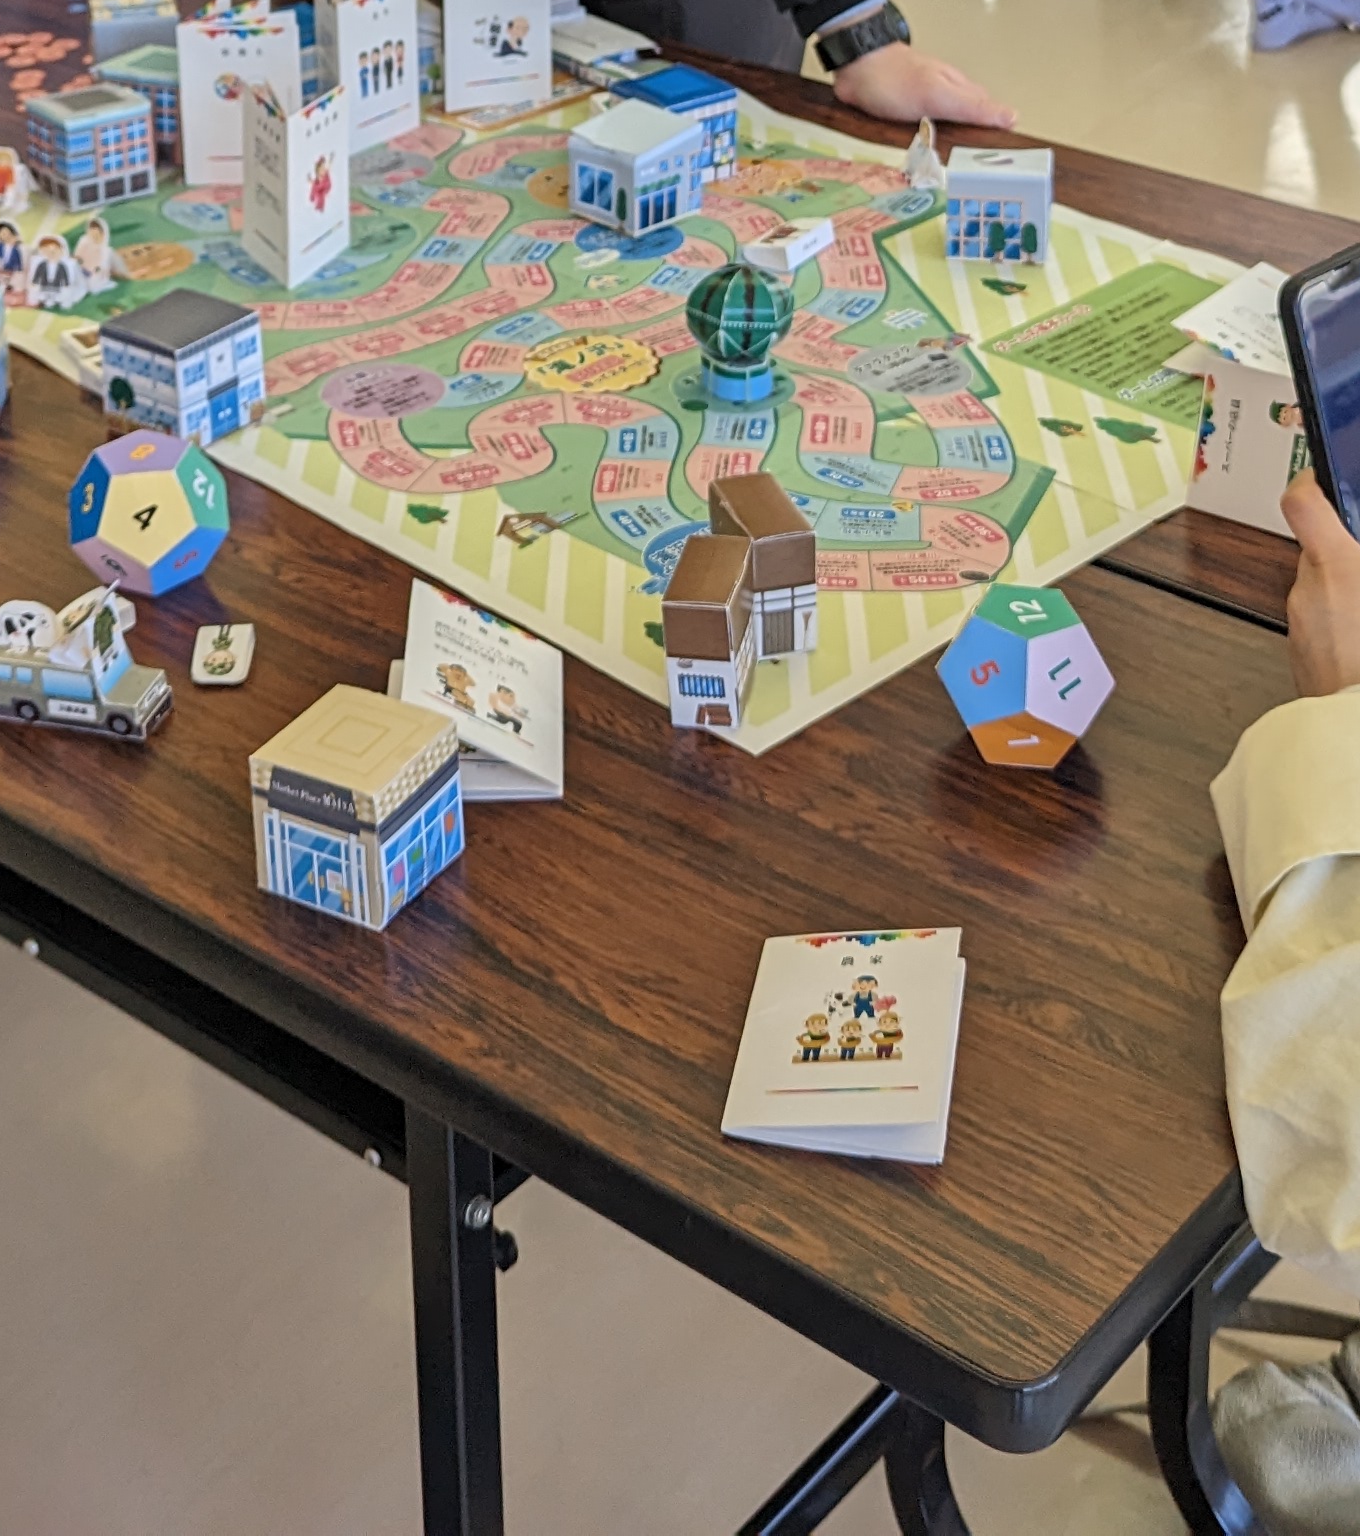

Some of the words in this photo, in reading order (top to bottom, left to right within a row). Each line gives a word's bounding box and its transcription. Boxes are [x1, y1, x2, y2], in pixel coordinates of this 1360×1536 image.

[192, 468, 216, 508] 12
[132, 504, 159, 531] 4
[1009, 599, 1048, 624] 12
[970, 660, 1000, 686] 5
[1048, 657, 1082, 700] 11
[1007, 734, 1040, 747] 1
